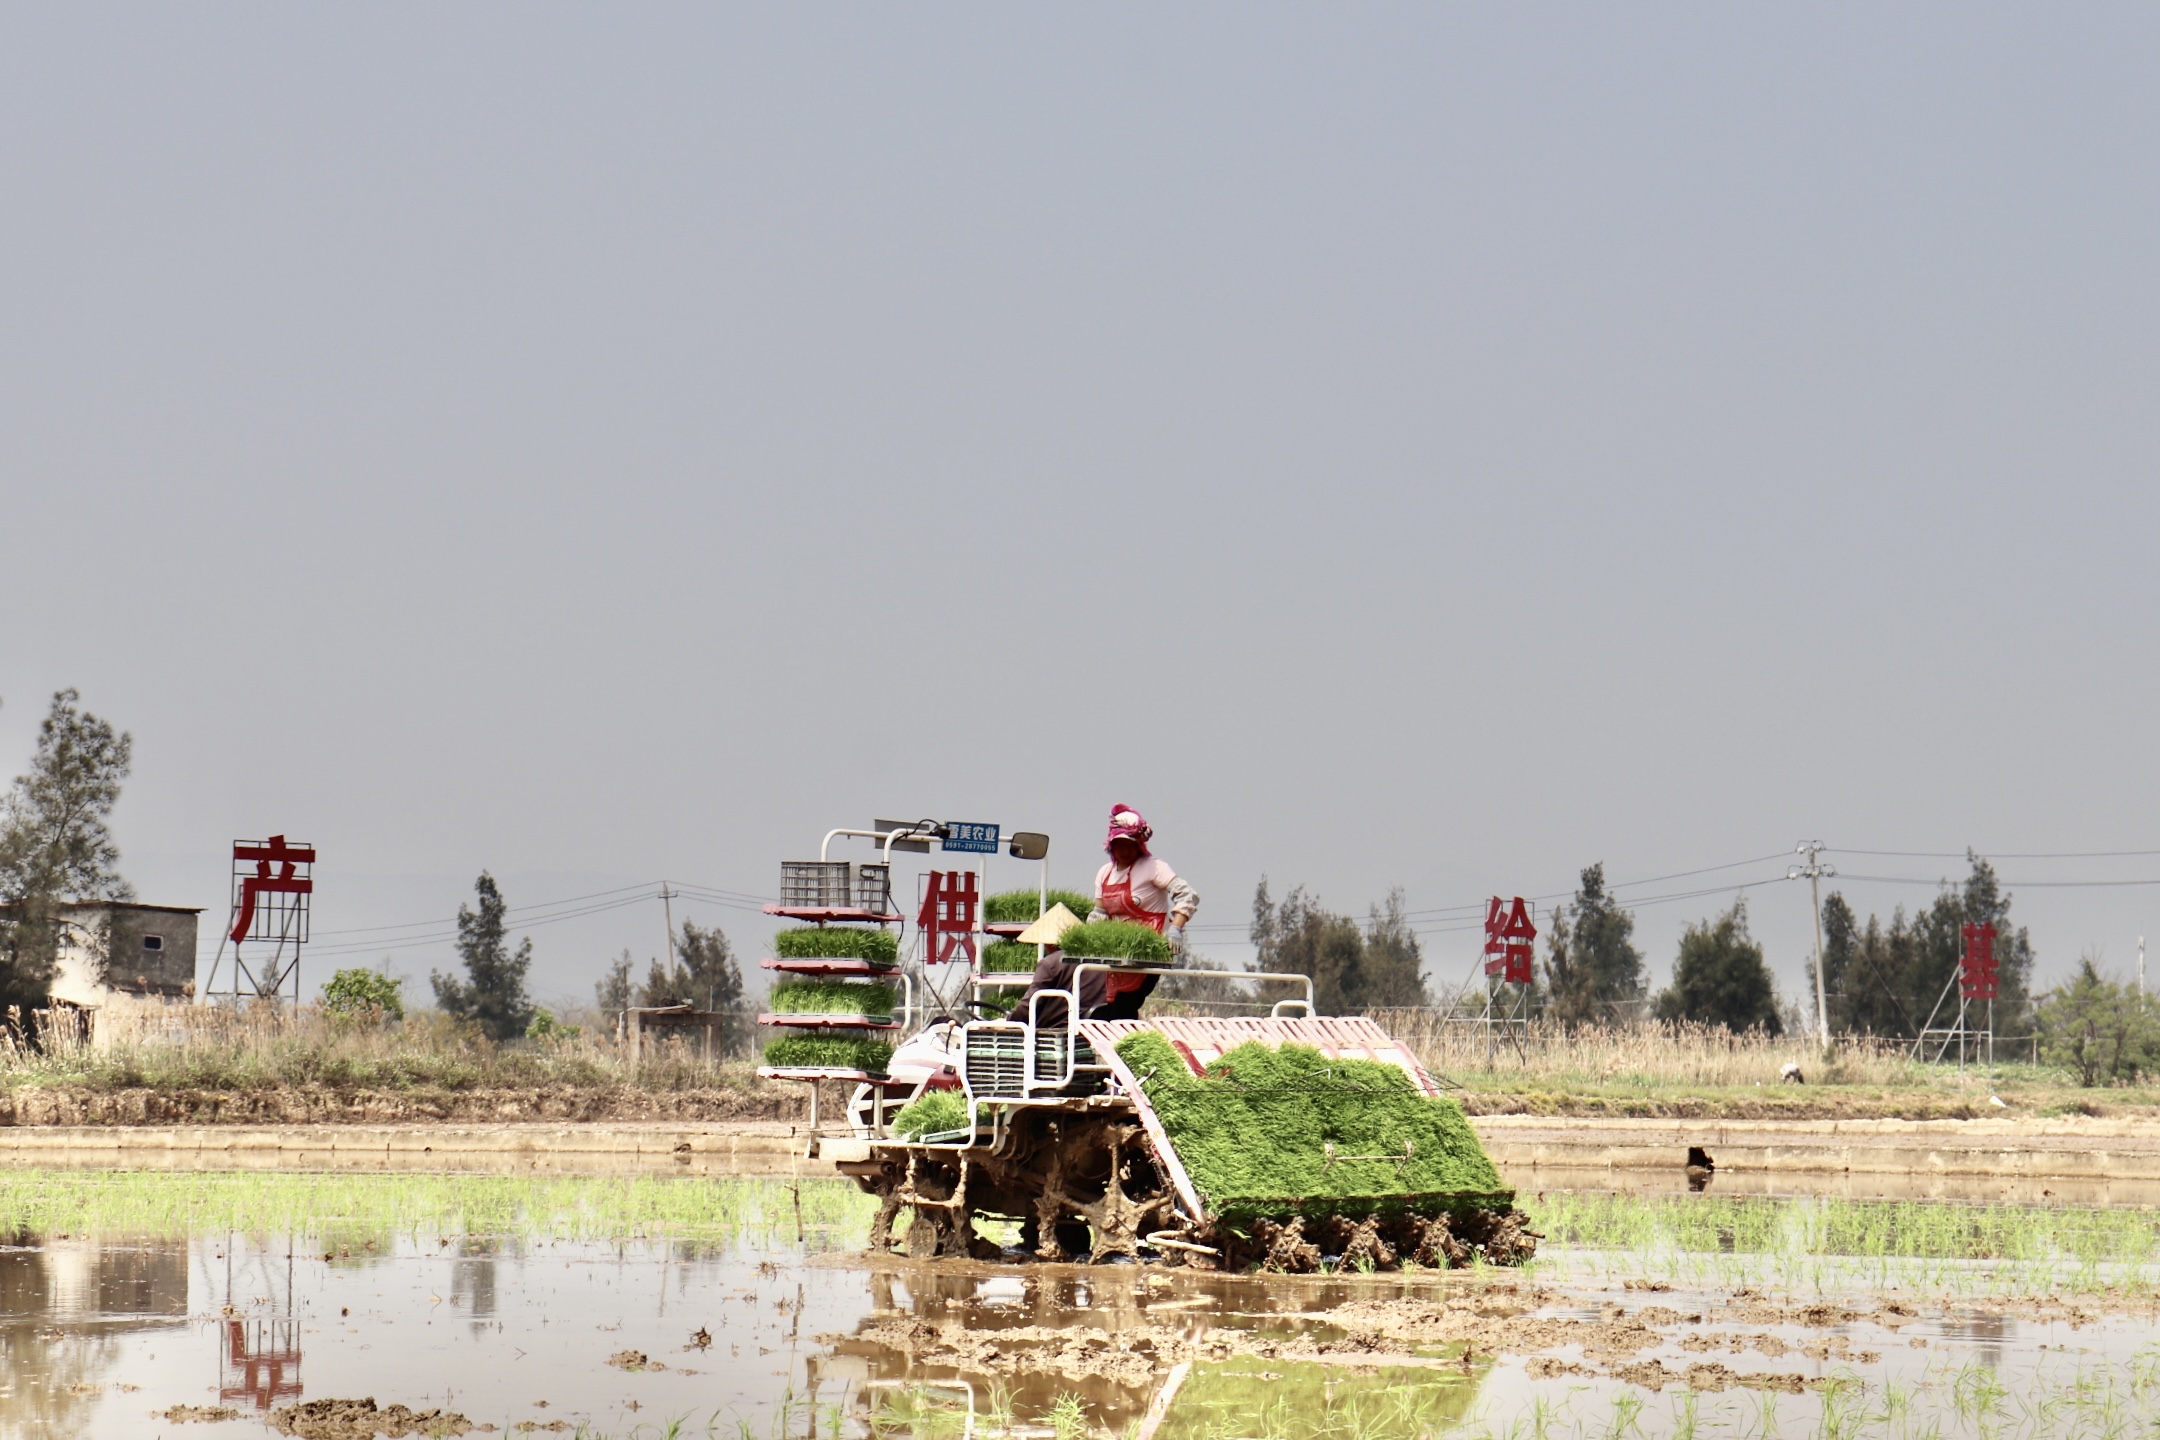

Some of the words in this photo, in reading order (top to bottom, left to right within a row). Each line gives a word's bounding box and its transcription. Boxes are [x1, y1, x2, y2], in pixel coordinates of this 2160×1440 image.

[230, 835, 315, 944] 产
[918, 871, 979, 966] 供
[1485, 894, 1537, 983] 给
[1957, 919, 1999, 999] 基
